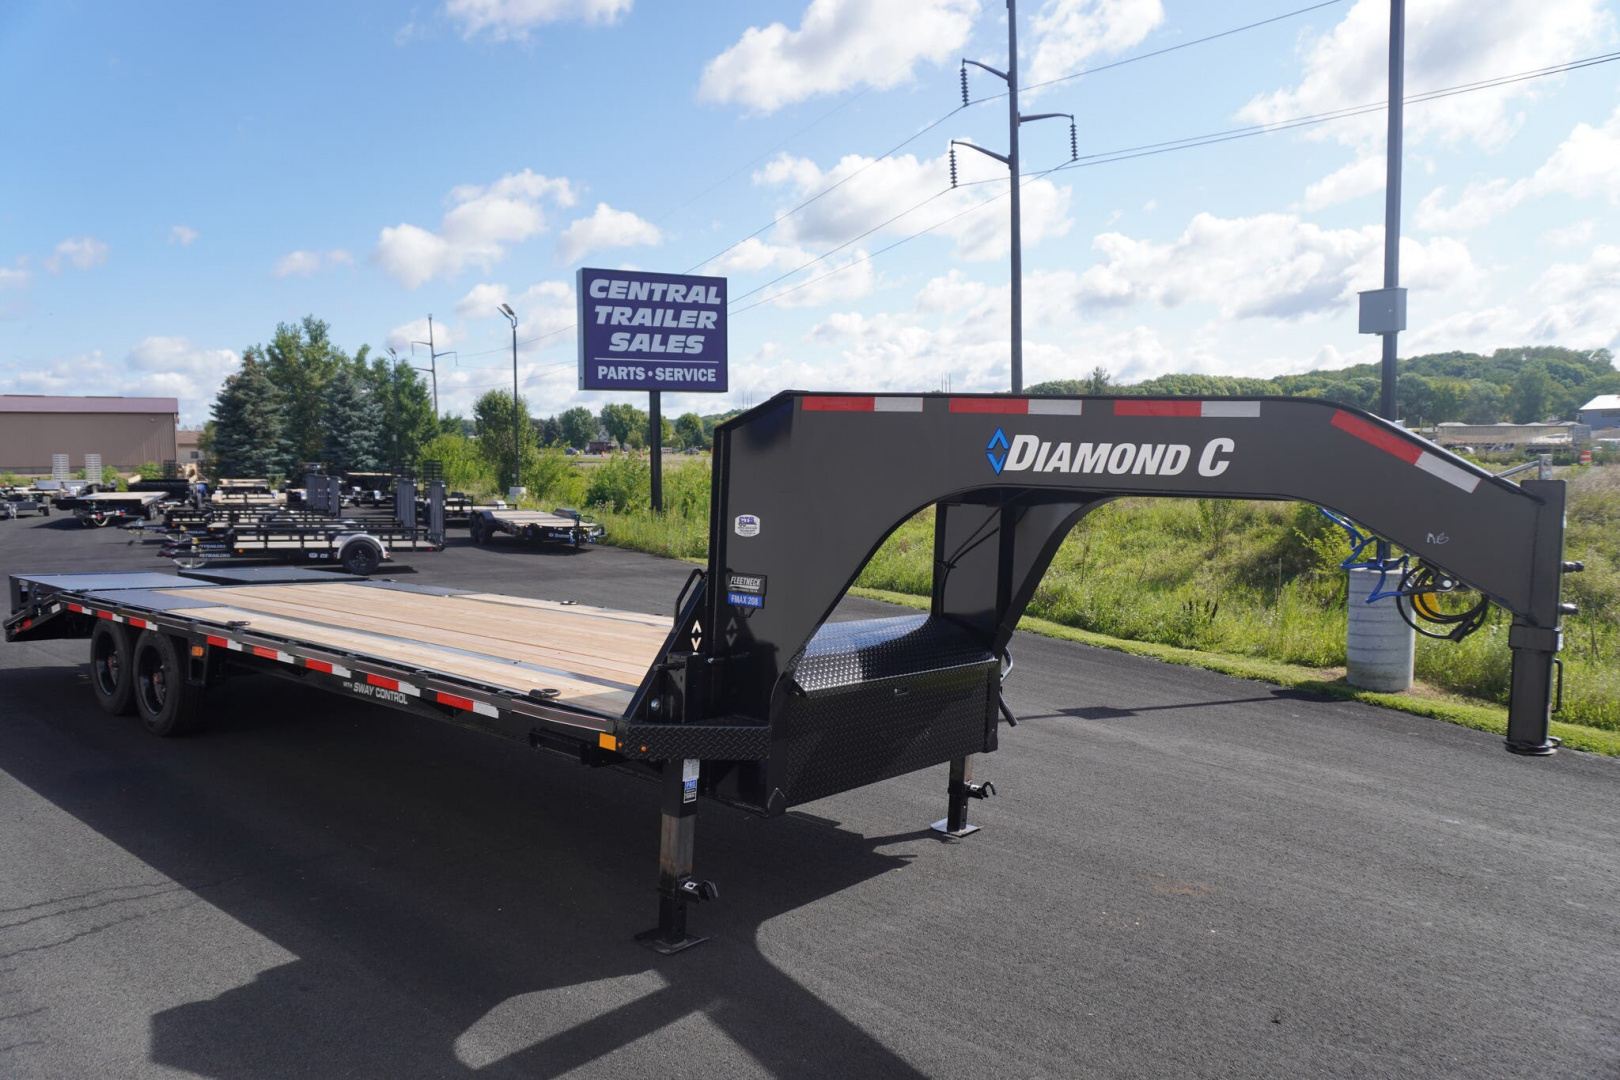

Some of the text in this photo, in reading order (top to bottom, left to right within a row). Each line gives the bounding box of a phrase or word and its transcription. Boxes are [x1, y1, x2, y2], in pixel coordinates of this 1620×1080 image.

[589, 278, 722, 305] CENTRAL
[594, 305, 718, 330] TRAILER
[608, 332, 706, 355] SALES
[597, 365, 717, 382] PARTS SERVICE
[1003, 434, 1236, 477] DIAMOND C
[730, 576, 762, 587] FLEETNECK
[353, 682, 375, 696] SWAY
[375, 687, 409, 705] CONTROL
